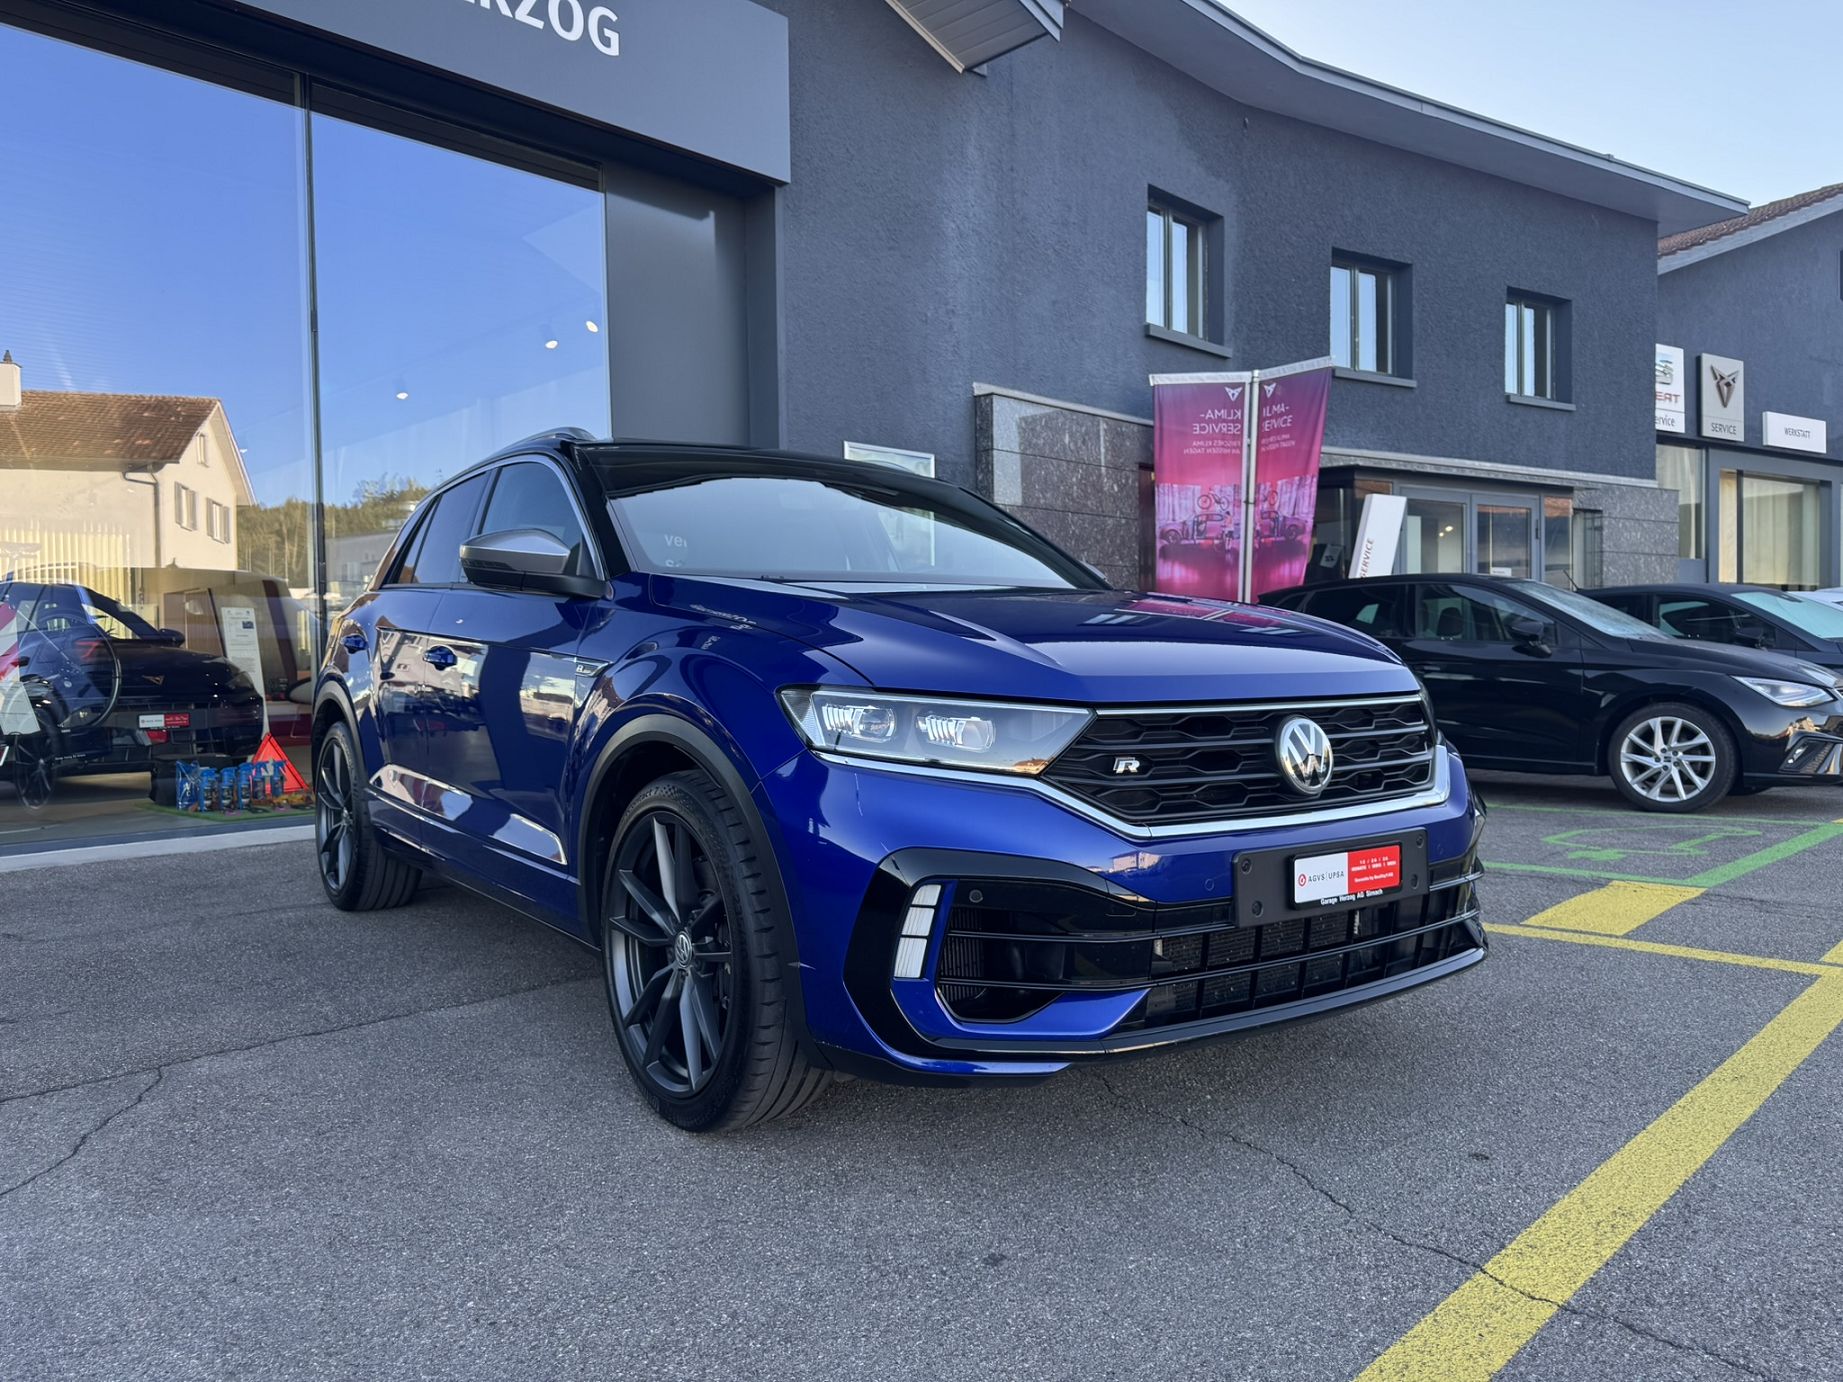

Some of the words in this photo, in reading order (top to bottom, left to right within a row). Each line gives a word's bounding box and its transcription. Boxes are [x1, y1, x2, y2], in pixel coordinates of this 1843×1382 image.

[1656, 391, 1681, 403] EAT
[1711, 422, 1737, 436] SERVICE
[1784, 427, 1811, 439] WERKSTATT
[1360, 537, 1375, 578] SERVICE
[1113, 757, 1140, 773] R
[1309, 874, 1325, 882] AGVS
[1328, 871, 1345, 880] UPSA
